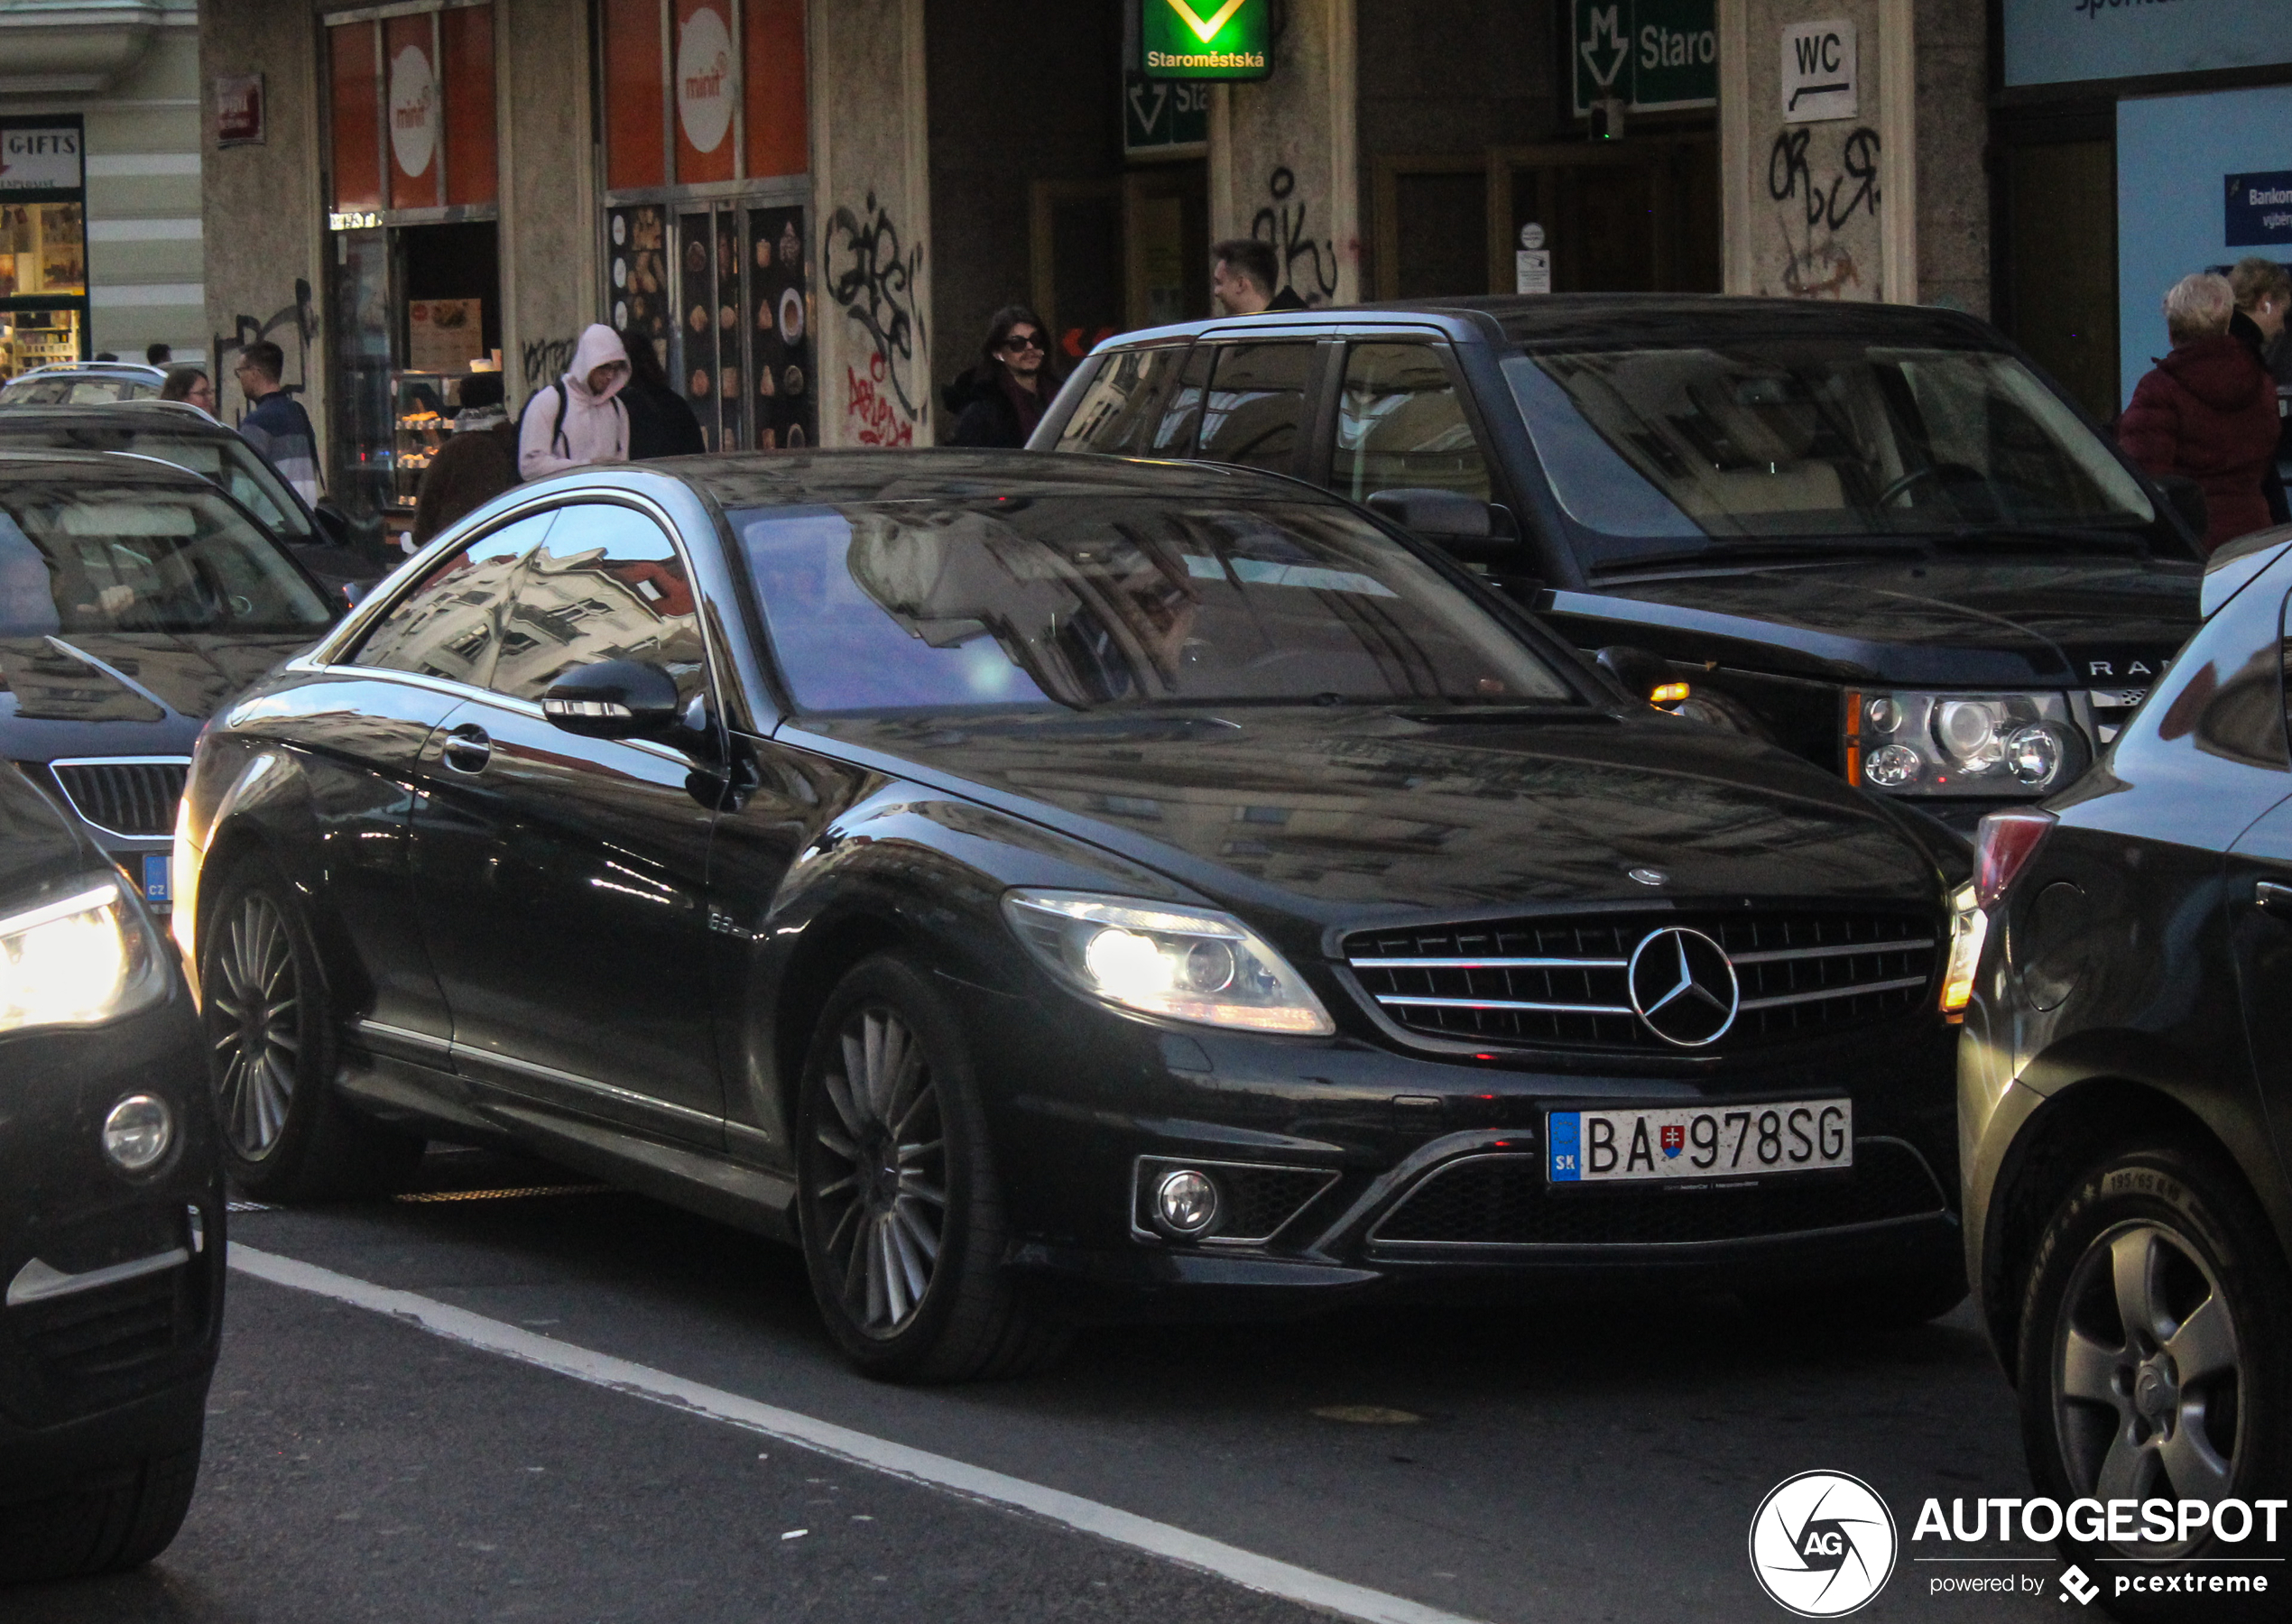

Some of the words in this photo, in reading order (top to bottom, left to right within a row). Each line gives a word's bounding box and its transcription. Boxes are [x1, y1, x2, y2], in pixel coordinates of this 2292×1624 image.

[1640, 24, 1714, 69] Staro
[1795, 32, 1841, 74] WC
[1147, 51, 1264, 68] Staroměstská
[9, 135, 76, 154] GIFTS
[149, 884, 165, 896] CZ
[1555, 1155, 1576, 1171] SK
